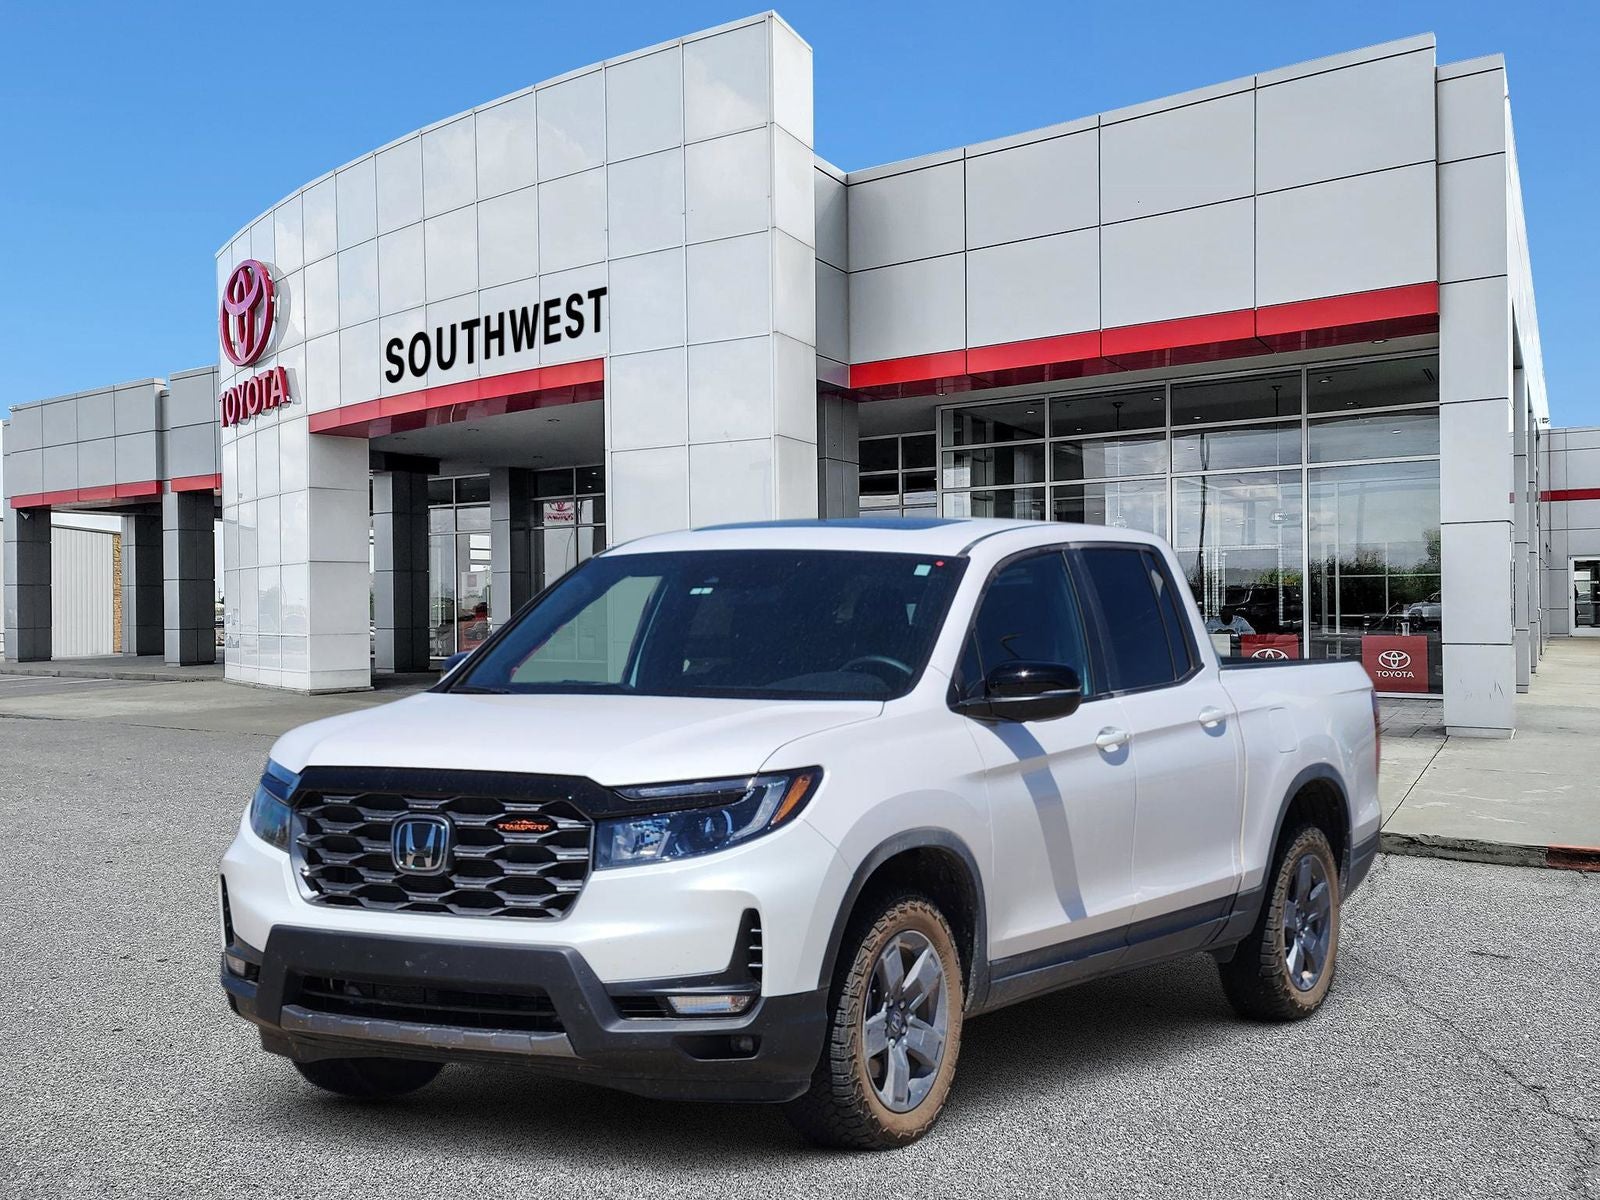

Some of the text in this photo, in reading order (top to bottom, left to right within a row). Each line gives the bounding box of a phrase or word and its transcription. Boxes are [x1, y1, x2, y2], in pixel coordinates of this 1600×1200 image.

[385, 286, 608, 384] SOUTHWEST
[218, 366, 291, 428] TOYOTA
[1376, 670, 1414, 678] TOYOTA
